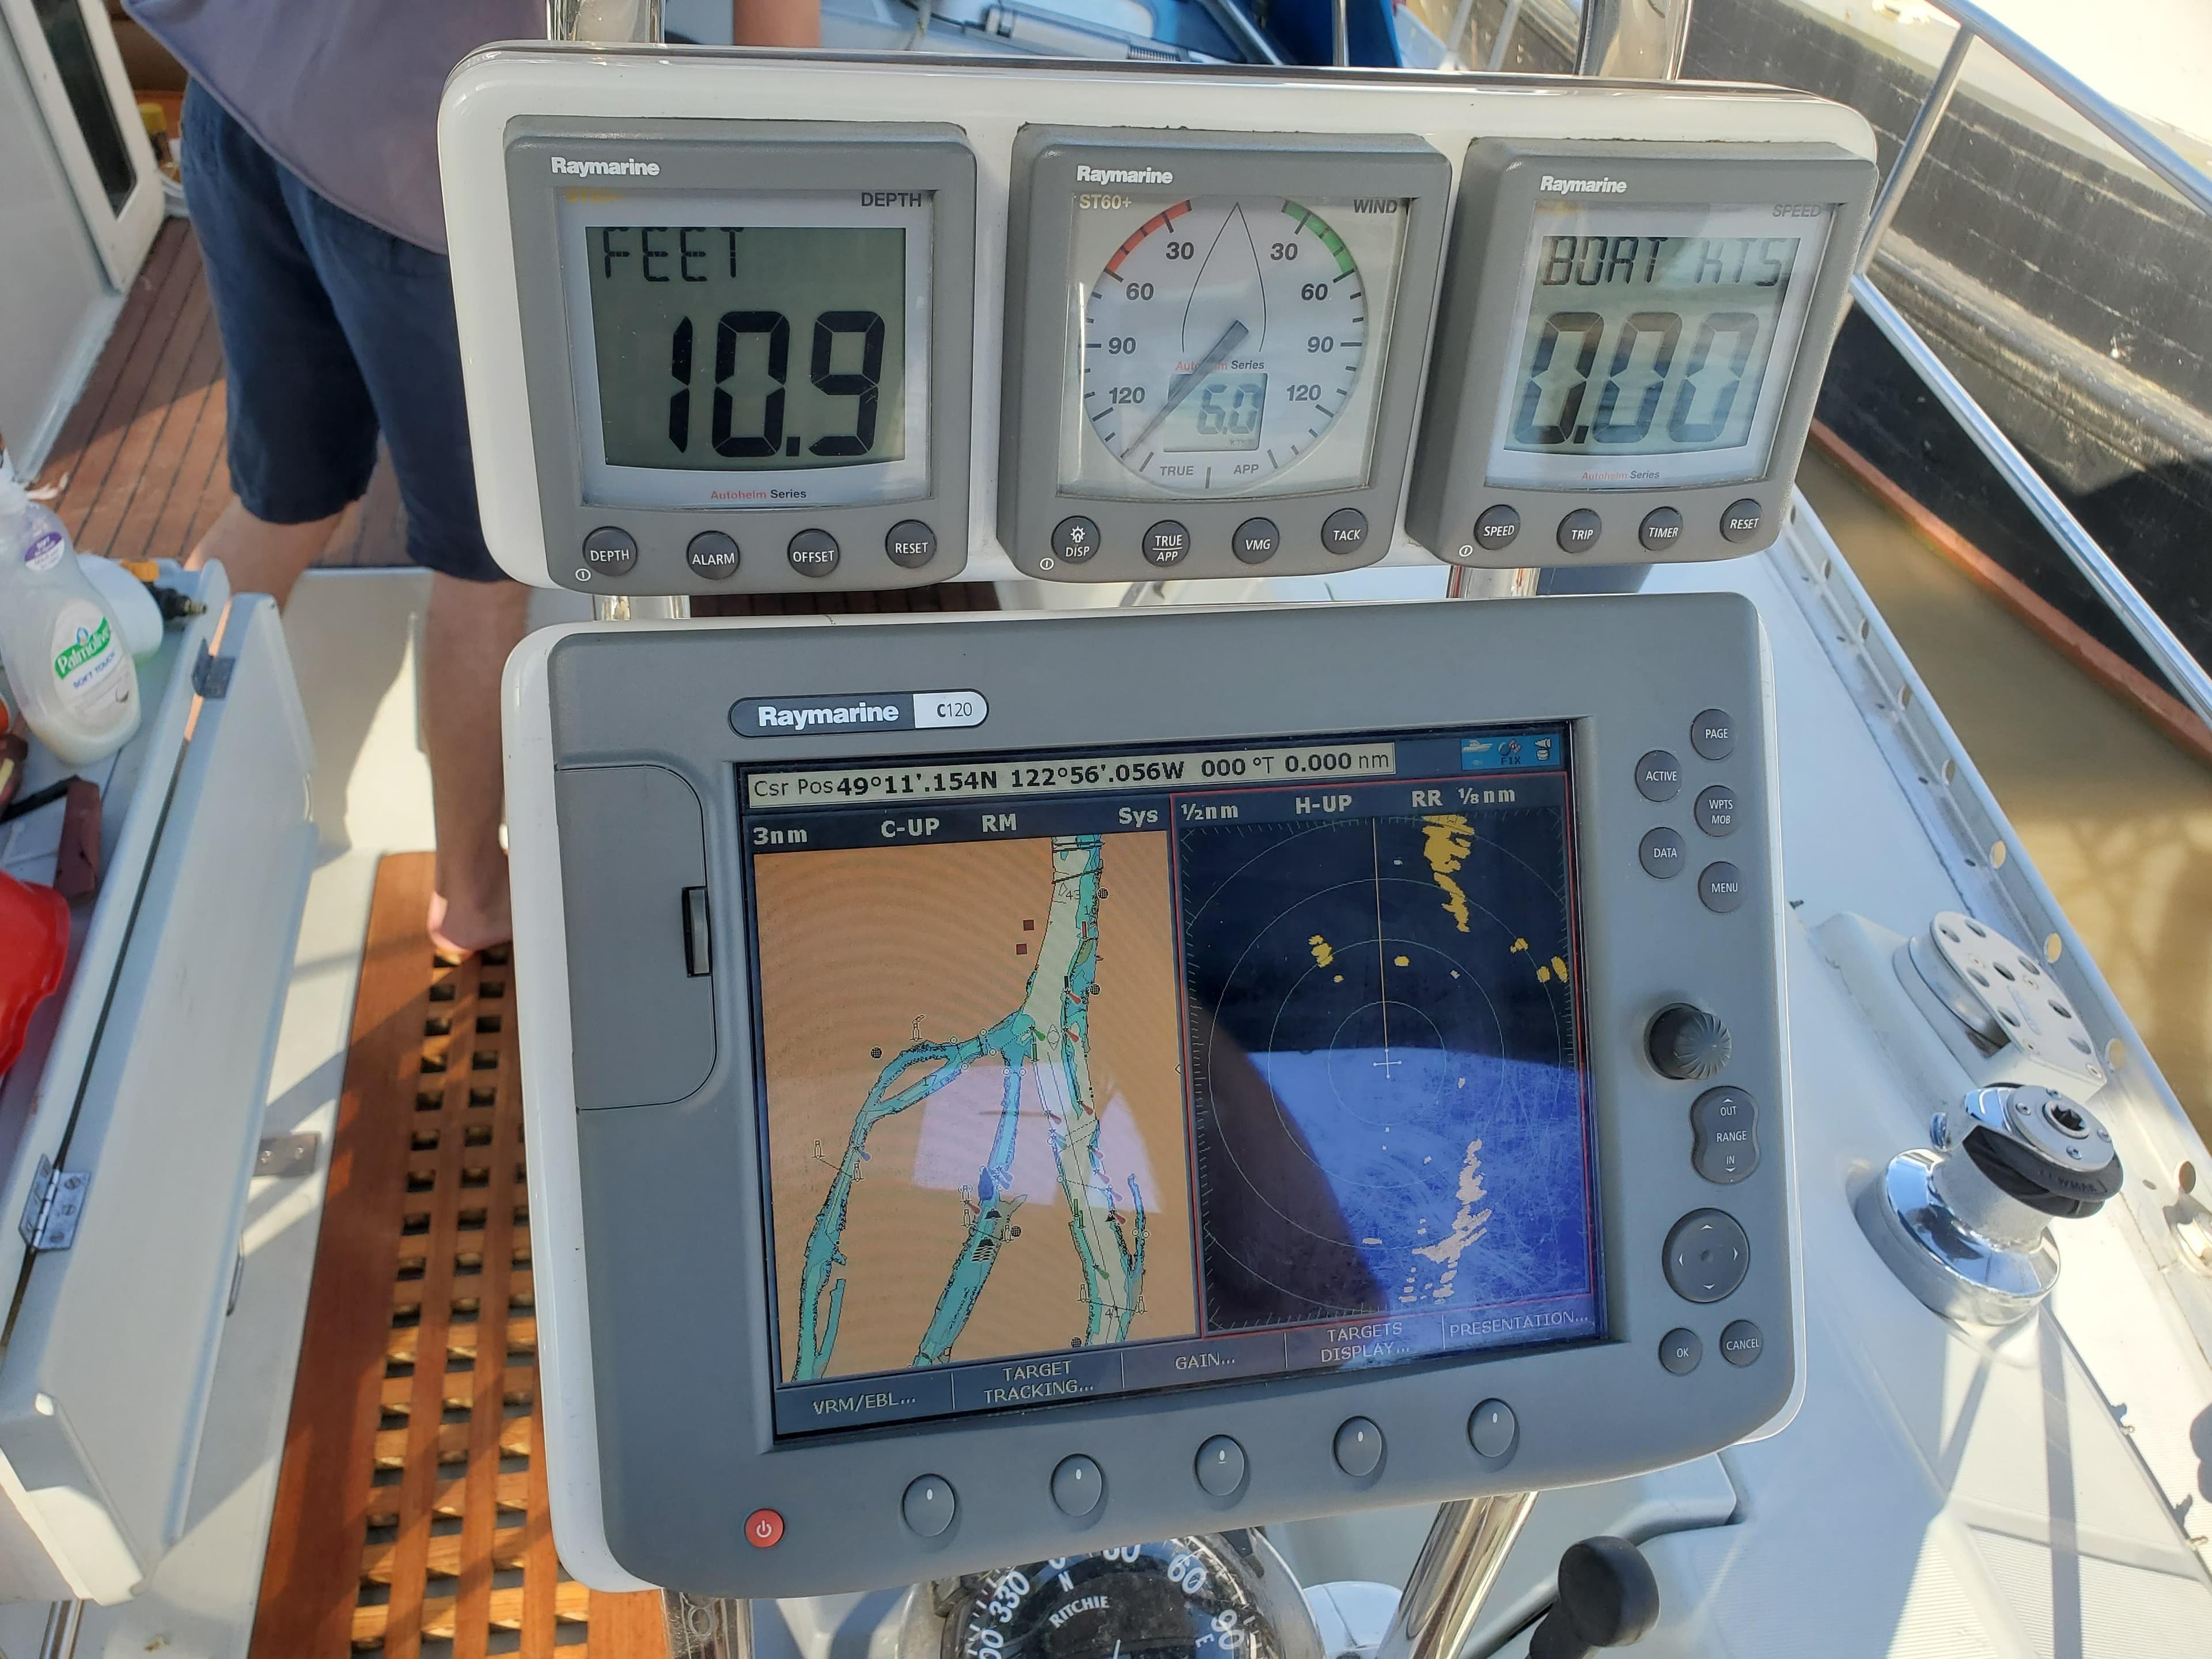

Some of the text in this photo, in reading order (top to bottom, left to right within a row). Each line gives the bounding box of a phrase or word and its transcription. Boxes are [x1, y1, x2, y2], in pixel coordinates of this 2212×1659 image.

[551, 157, 660, 177] Raymarine
[1077, 165, 1173, 184] Raymarine
[1540, 176, 1627, 195] Raymarine
[861, 192, 922, 207] DEPTH
[1079, 195, 1132, 209] ST60+
[1353, 199, 1397, 214] WIND
[1772, 204, 1820, 218] SPEED
[603, 226, 744, 282] FEET
[1165, 242, 1195, 260] 30
[1270, 243, 1298, 260] 30
[1542, 236, 1788, 287] BOAT KTS
[1126, 283, 1154, 301] 60
[1301, 283, 1328, 301] 60
[1108, 337, 1136, 355] 90
[1306, 336, 1334, 354] 90
[1231, 360, 1264, 369] Series
[669, 310, 885, 457] 10.9
[1514, 312, 1759, 444] 0.00
[1109, 387, 1146, 404] 120
[1286, 384, 1321, 402] 120
[1197, 384, 1263, 434] 6.0
[1160, 465, 1194, 477] TRUE
[1233, 464, 1259, 475] APP
[1582, 470, 1660, 481] Autohelm Series
[711, 488, 806, 499] Autohelm Series
[1484, 525, 1514, 537] SPEED
[1729, 518, 1759, 529] RESET
[1333, 529, 1360, 542] TACK
[1571, 529, 1593, 540] TRIP
[1648, 527, 1679, 539] TIMER
[895, 541, 928, 555] RESET
[1155, 535, 1182, 547] TRUE
[1245, 539, 1271, 551] VMG
[590, 548, 630, 563] DEPTH
[692, 551, 735, 566] ALARM
[793, 549, 835, 564] OFFSET
[1065, 546, 1090, 558] DISP
[1156, 551, 1178, 562] APP
[58, 626, 110, 674] Palmolive
[757, 701, 899, 730] Raymarine
[1705, 729, 1728, 738] PAGE
[754, 779, 789, 797] Csr
[798, 776, 833, 795] Pos
[1202, 758, 1245, 777] 000
[1285, 753, 1351, 773] 0.000
[1358, 752, 1389, 769] nm
[1646, 771, 1677, 781] ACTIVE
[1296, 795, 1352, 815] H-UP
[1412, 790, 1443, 807] RR
[1709, 800, 1733, 809] WPTS
[753, 806, 1158, 844] 3nm C-UP RM Sys
[1711, 815, 1730, 824] MOB
[1654, 848, 1677, 858] DATA
[1711, 883, 1738, 893] MENU
[1720, 1106, 1736, 1116] OUT
[1717, 1131, 1747, 1142] RANGE
[1726, 1156, 1734, 1165] IN
[1327, 1322, 1403, 1343] TARGETS
[1726, 1338, 1759, 1350] CANCEL
[1677, 1347, 1689, 1358] OK
[1003, 1360, 1073, 1381] TARGET
[1058, 1571, 1074, 1592] N
[1167, 1554, 1207, 1594] 60
[990, 1571, 1030, 1623] 330
[1049, 1596, 1110, 1629] RITCHIE
[1211, 1609, 1244, 1651] 90
[1195, 1634, 1214, 1648] E
